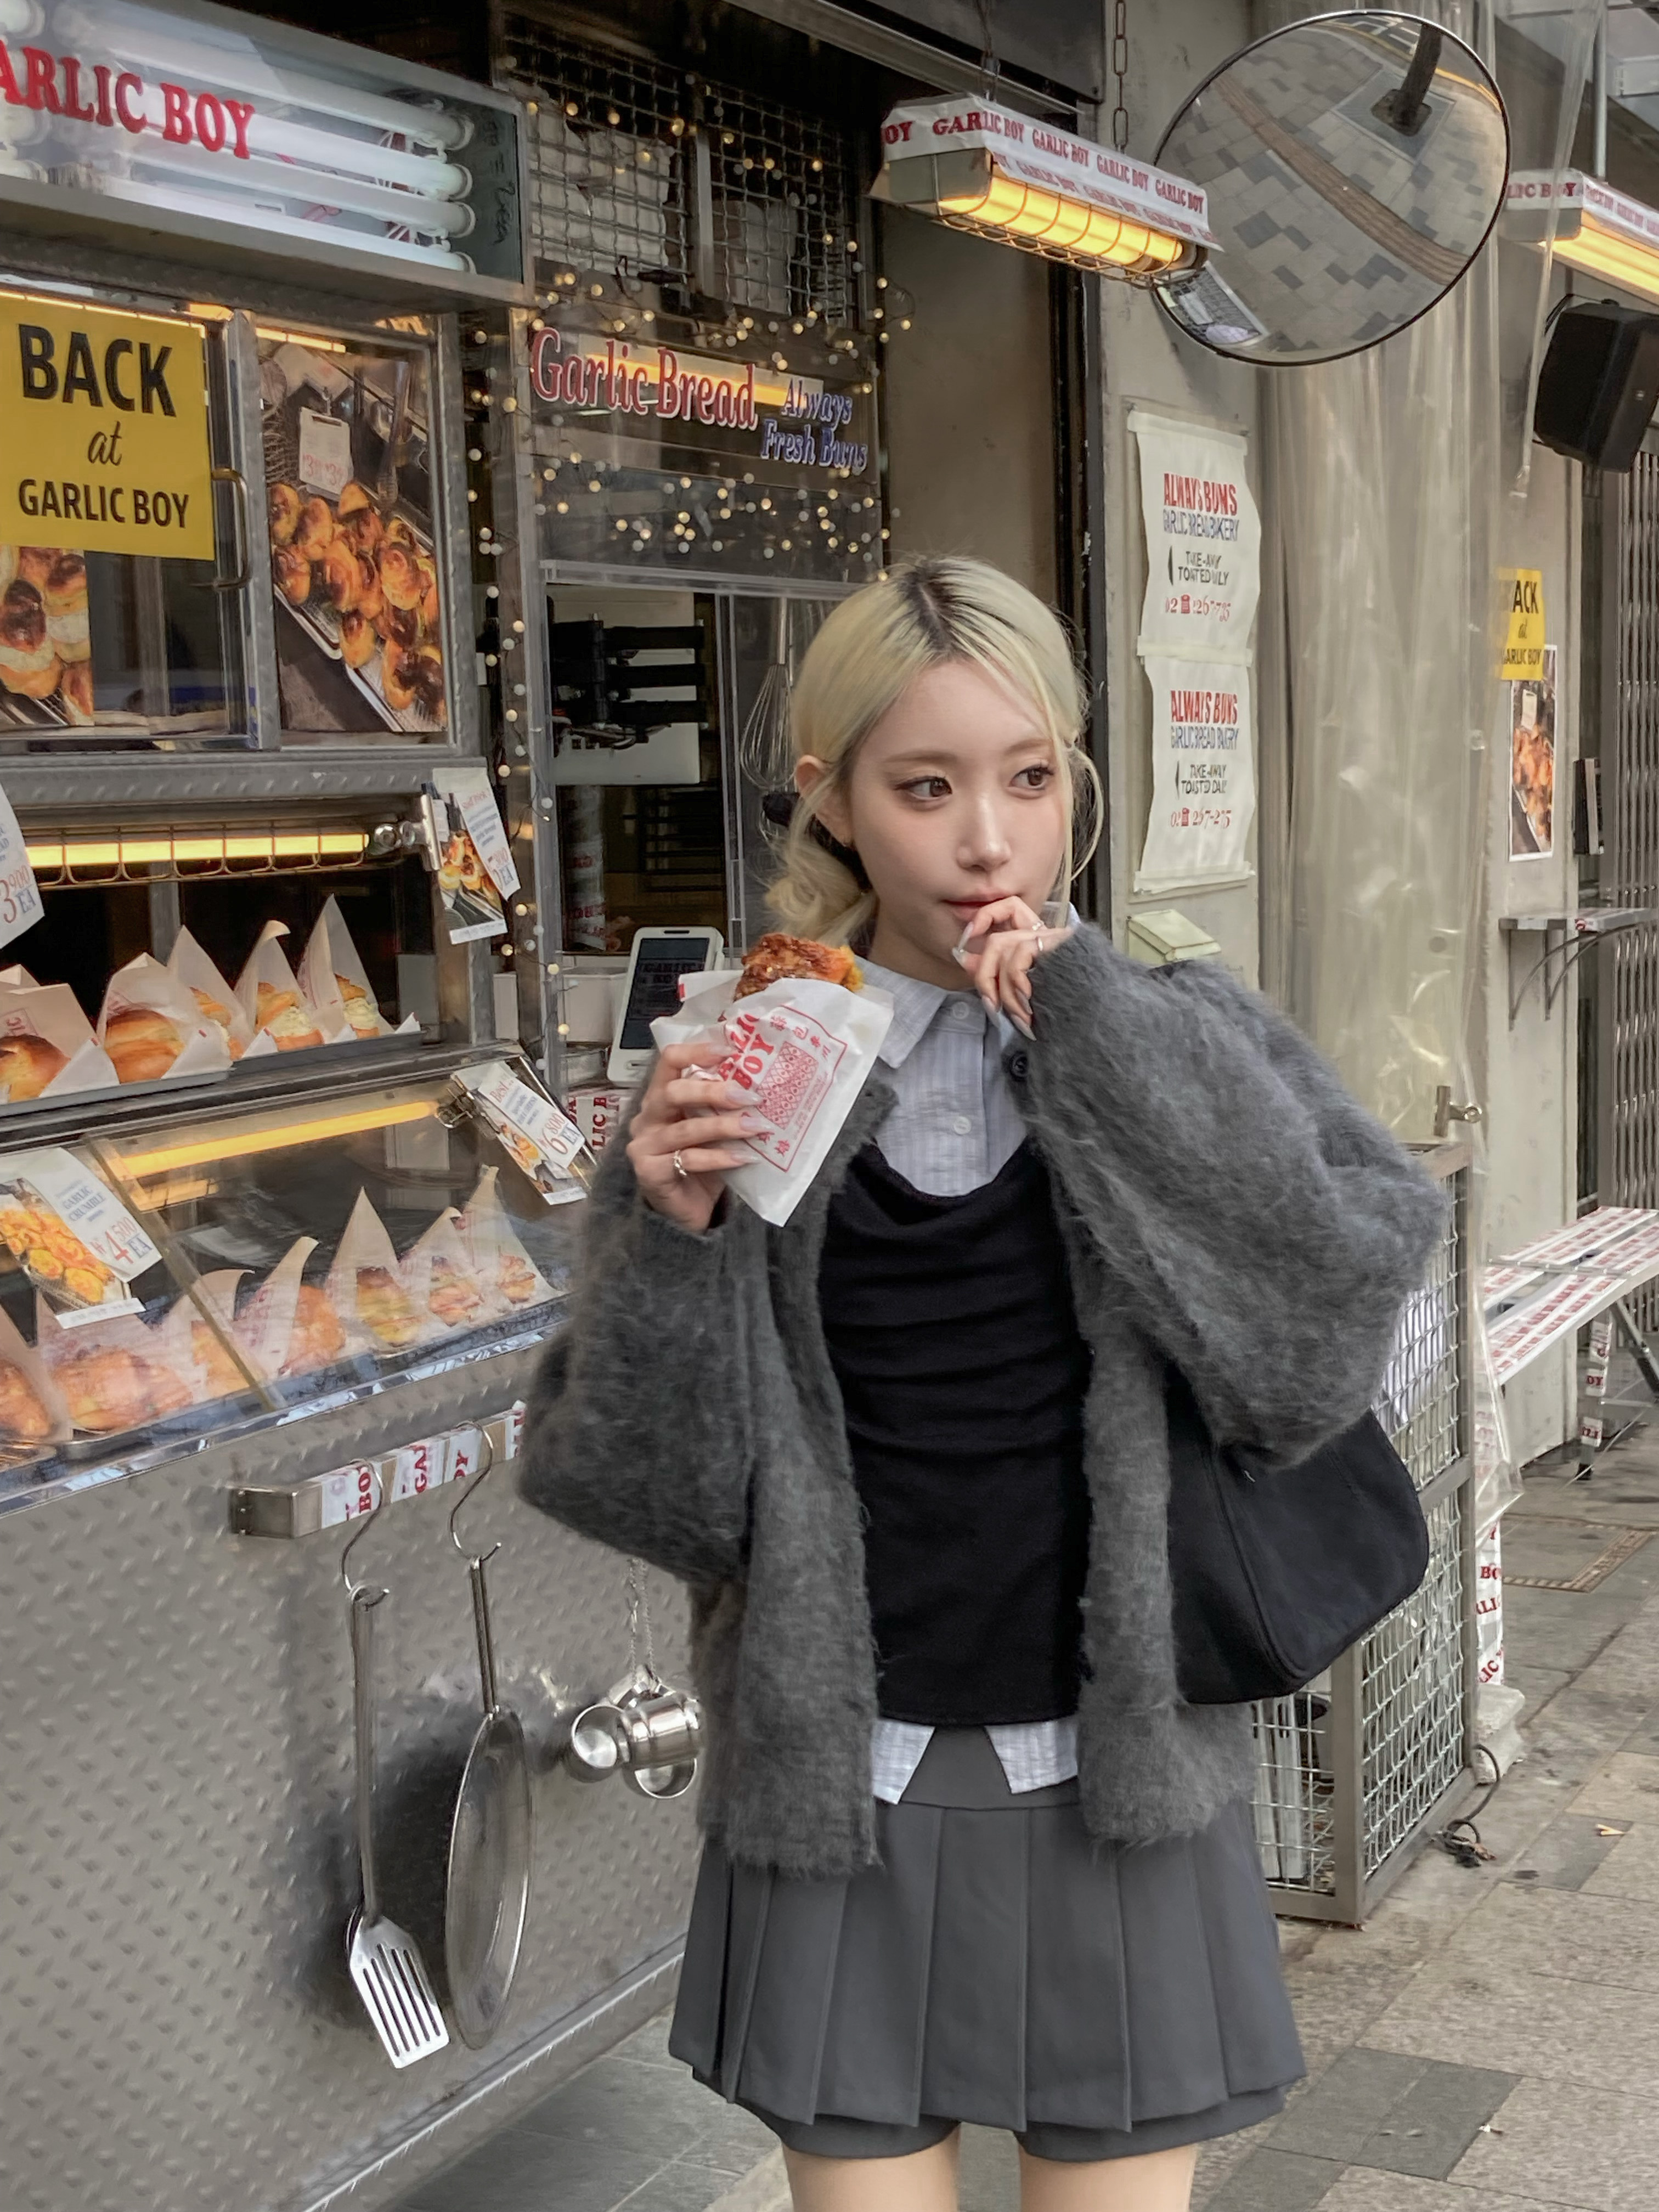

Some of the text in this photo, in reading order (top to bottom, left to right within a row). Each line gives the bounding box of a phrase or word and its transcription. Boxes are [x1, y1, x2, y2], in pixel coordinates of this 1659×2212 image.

[0, 40, 255, 159] ARLIC BOY
[882, 121, 913, 144] OY
[933, 111, 1001, 136] GARLIC
[1004, 117, 1024, 143] BOY
[1032, 128, 1069, 159] GARLIC
[1071, 143, 1090, 167] BOY
[1097, 154, 1130, 184] GARLIC
[1132, 168, 1149, 191] BOY
[1155, 179, 1186, 207] GARLIC
[1188, 191, 1204, 215] BOY
[19, 324, 177, 417] BACK
[529, 327, 758, 431] Garlic Bread
[781, 377, 853, 431] Always
[88, 421, 122, 466] at
[760, 418, 868, 473] Fresh Buns
[19, 479, 190, 528] GARLIC BOY
[1203, 481, 1238, 516] BUNS
[1511, 580, 1539, 614] ACK
[1503, 648, 1527, 665] ARLIC
[1212, 692, 1238, 725] BUNS
[732, 1033, 774, 1091] BOY
[68, 1192, 106, 1222] CRUMBLE
[126, 1234, 153, 1259] EA
